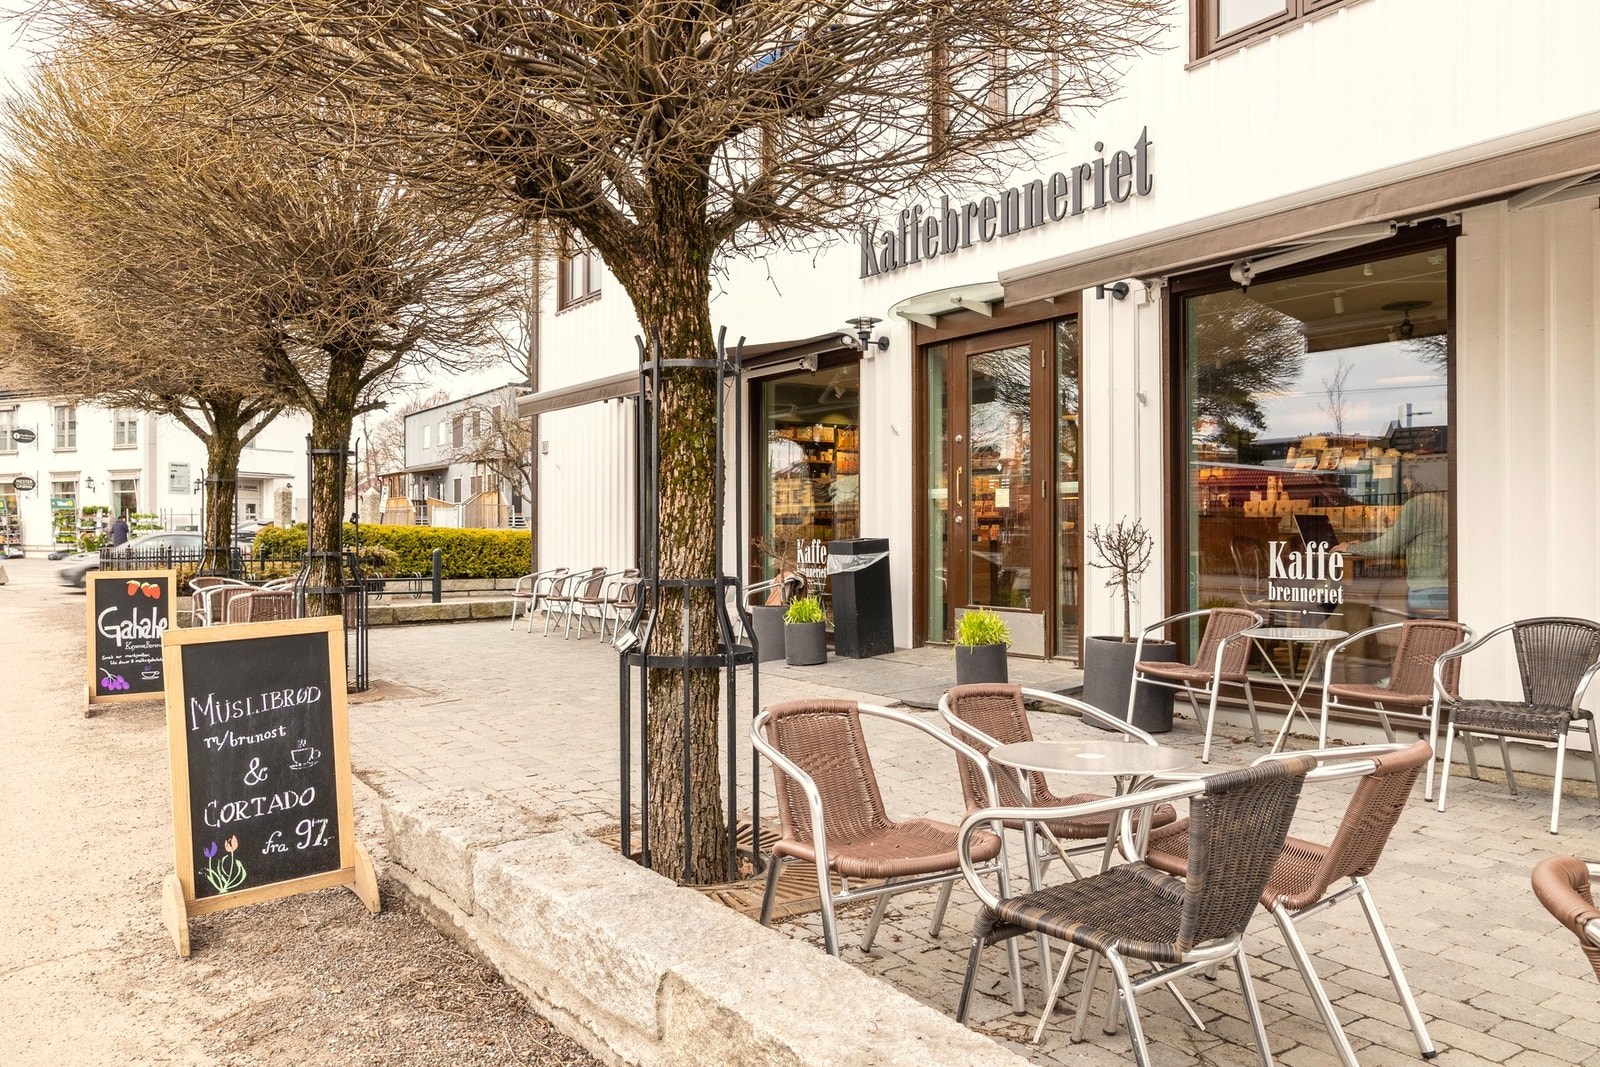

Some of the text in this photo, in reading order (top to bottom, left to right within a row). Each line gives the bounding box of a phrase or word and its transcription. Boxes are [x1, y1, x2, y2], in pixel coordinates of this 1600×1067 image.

[859, 125, 1153, 279] Kaffebrenneriet
[797, 539, 827, 564] Kaffe
[1268, 541, 1344, 581] Kaffe
[1268, 581, 1344, 604] brenneriet
[190, 685, 322, 731] MÜSLIBRØD
[203, 725, 287, 751] m/brunost
[243, 757, 268, 786] &
[204, 786, 316, 828] CORTADO
[262, 830, 289, 855] fra
